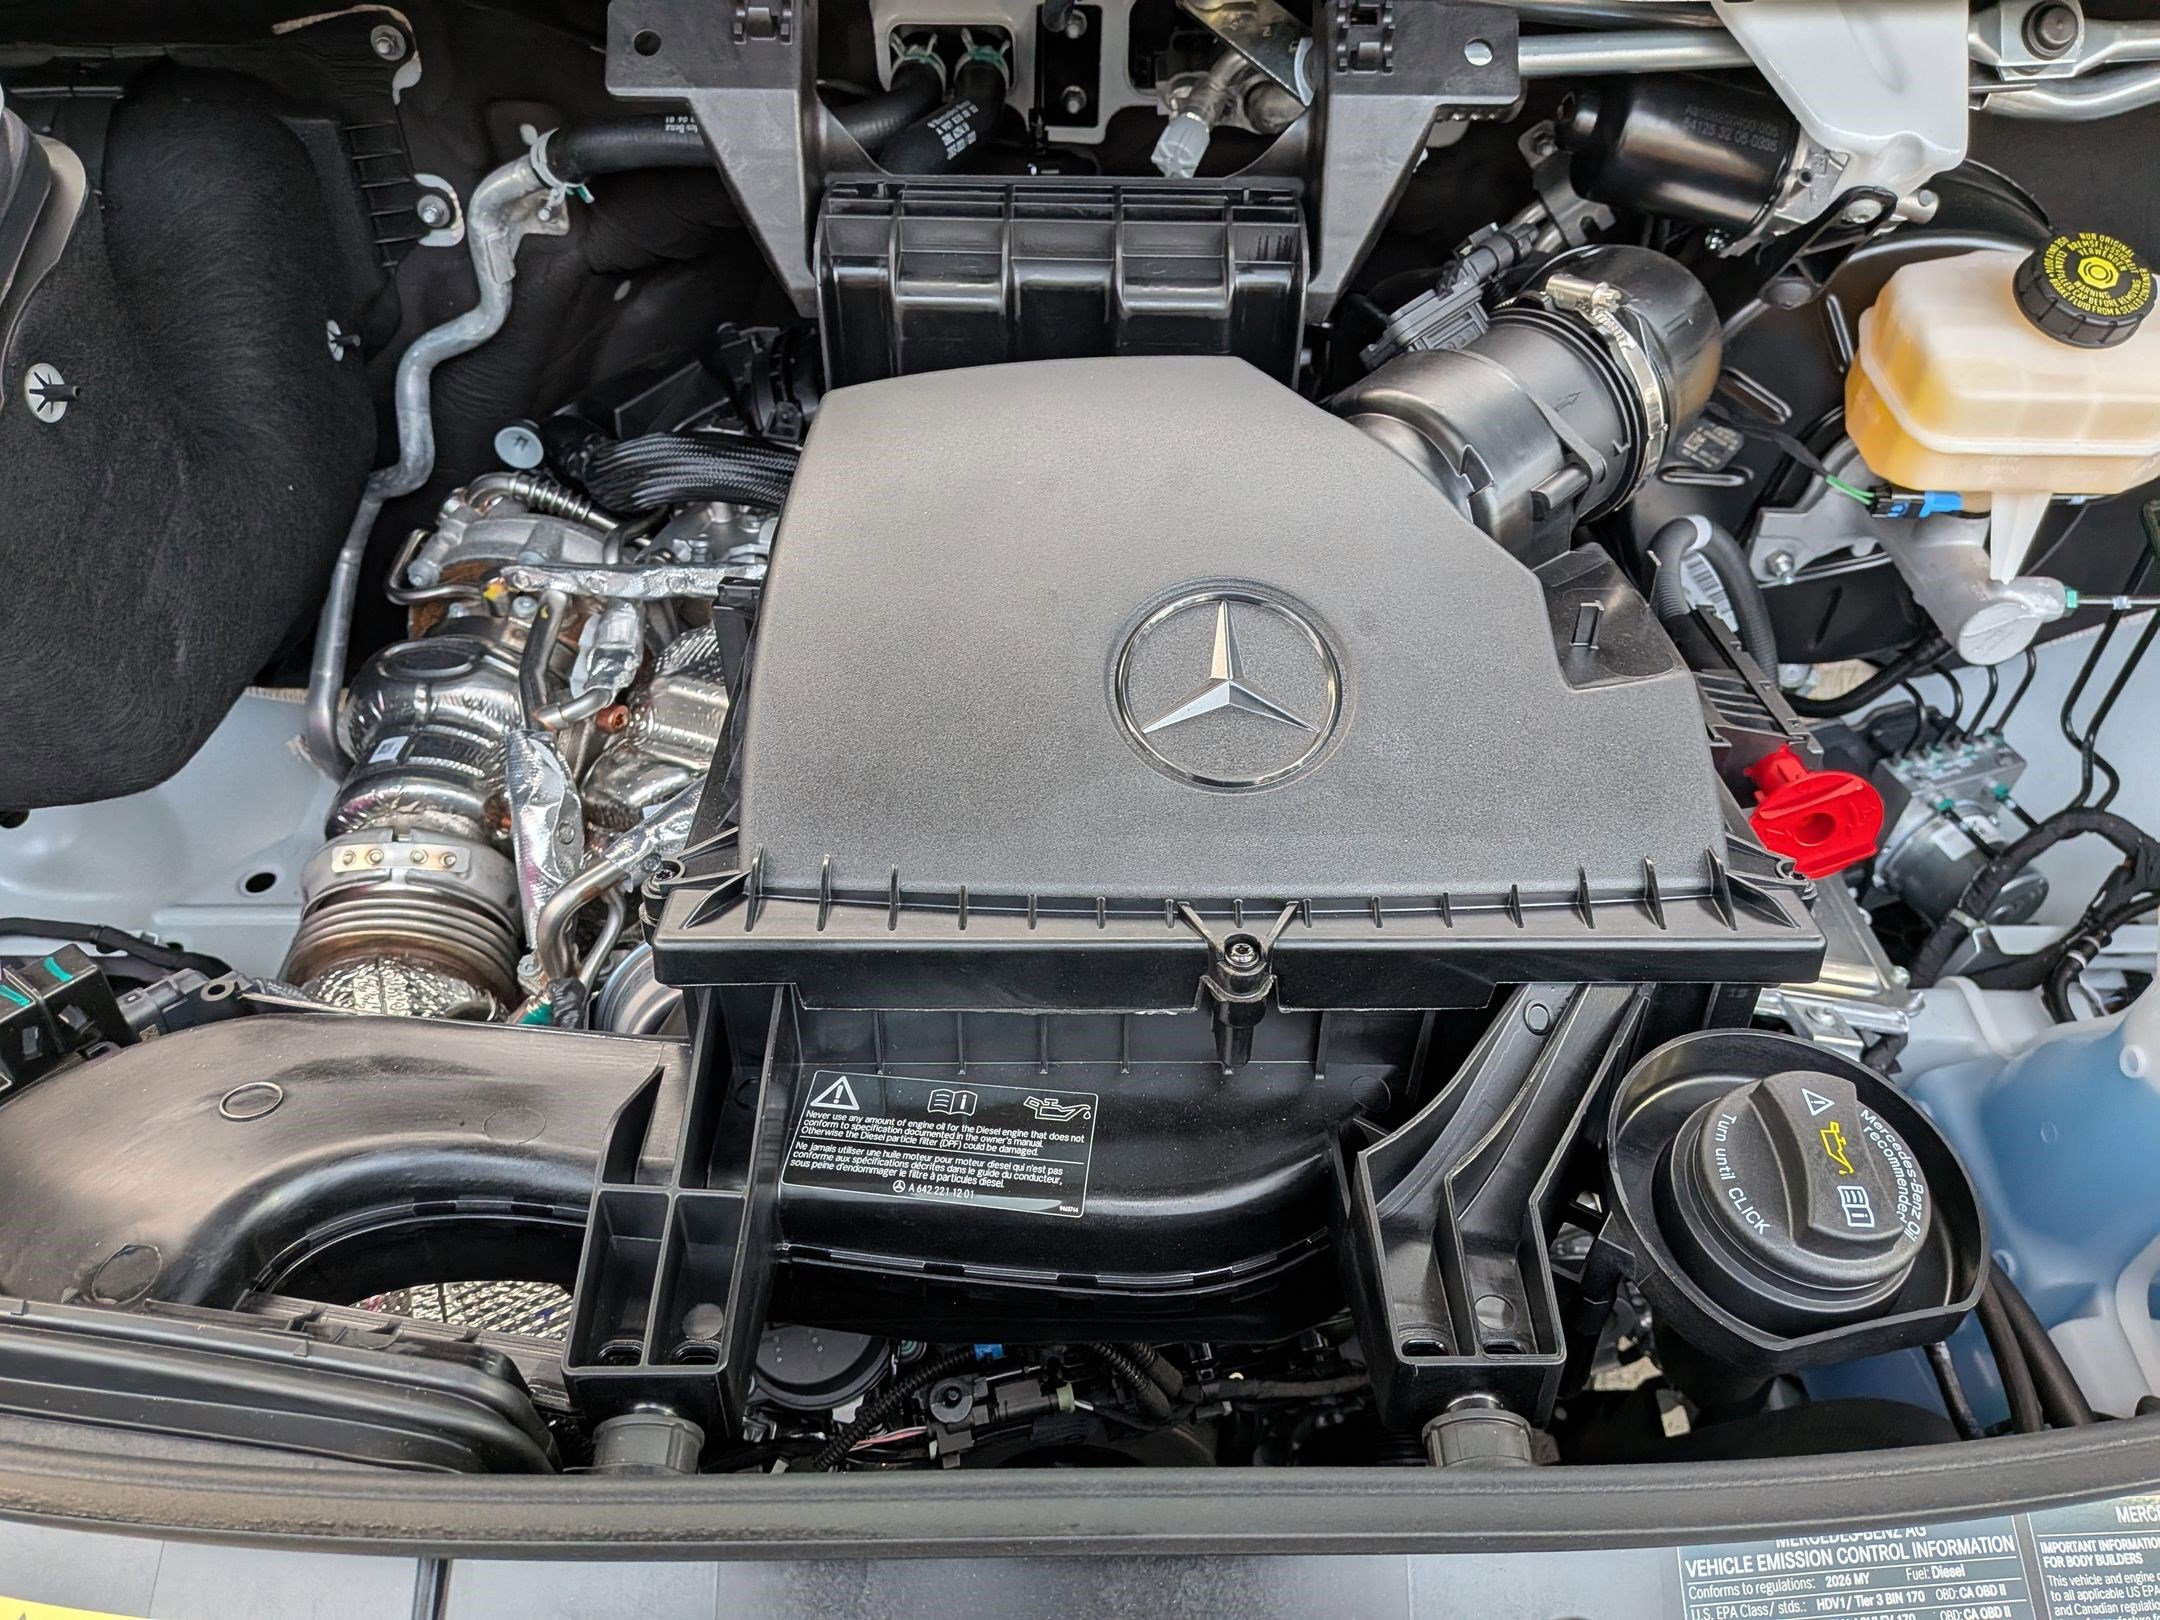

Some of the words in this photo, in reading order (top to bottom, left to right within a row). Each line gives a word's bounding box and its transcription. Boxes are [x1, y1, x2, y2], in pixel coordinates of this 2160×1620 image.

[2079, 232, 2097, 241] NUR
[2099, 234, 2135, 258] ORIGINAL
[2055, 250, 2068, 269] CLEAN
[2077, 247, 2128, 271] VERWENDEN
[2055, 270, 2075, 292] FILLER
[2073, 280, 2111, 300] WARNING
[2068, 296, 2091, 311] FLUID
[2092, 305, 2115, 316] FROM
[2120, 298, 2145, 314] SEALED
[2072, 290, 2089, 301] CAP
[2088, 297, 2120, 307] BEFORE
[803, 1118, 839, 1129] conform
[840, 1121, 849, 1130] to
[850, 1122, 903, 1136] specification
[904, 1127, 956, 1140] documented
[956, 1131, 964, 1140] in
[965, 1133, 979, 1142] the
[980, 1135, 1013, 1145] owner's
[805, 1110, 831, 1120] Never
[832, 1114, 848, 1122] use
[849, 1115, 864, 1123] any
[864, 1116, 895, 1126] amount
[896, 1119, 907, 1127] of
[907, 1121, 934, 1131] engine
[935, 1122, 946, 1130] oil
[947, 1123, 960, 1132] for
[961, 1125, 975, 1133] the
[976, 1125, 1001, 1136] Diesel
[1002, 1128, 1029, 1138] engine
[1030, 1130, 1047, 1140] that
[1048, 1132, 1069, 1142] does
[1070, 1134, 1085, 1143] not
[1715, 1113, 1737, 1142] Turn
[801, 1126, 844, 1137] Otherwise
[845, 1129, 860, 1139] the
[860, 1130, 886, 1141] Diesel
[885, 1133, 918, 1145] particle
[918, 1137, 938, 1147] filter
[939, 1139, 962, 1150] (DPF)
[963, 1141, 986, 1151] could
[986, 1143, 998, 1152] be
[998, 1145, 1039, 1157] damaged.
[792, 1150, 835, 1162] conforme
[835, 1154, 850, 1163] aux
[851, 1155, 909, 1169] spécifications
[910, 1160, 946, 1172] décrites
[946, 1163, 967, 1174] dans
[967, 1166, 976, 1175] le
[976, 1168, 1000, 1179] guide
[1001, 1170, 1012, 1179] du
[1013, 1172, 1063, 1186] conducteur,
[795, 1141, 809, 1151] Ne
[808, 1142, 837, 1154] jamais
[838, 1145, 865, 1156] utiliser
[866, 1148, 882, 1157] une
[882, 1149, 902, 1159] huile
[902, 1151, 935, 1162] moteur
[935, 1155, 954, 1166] pour
[954, 1157, 985, 1168] moteur
[987, 1160, 1012, 1171] diesel
[1012, 1163, 1026, 1173] qui
[1026, 1164, 1047, 1175] n'est
[1047, 1167, 1064, 1177] pas
[1715, 1148, 1736, 1180] until
[790, 1160, 811, 1168] sous
[811, 1161, 835, 1171] peine
[836, 1163, 897, 1178] d'endommager
[899, 1169, 907, 1178] le
[908, 1170, 929, 1180] filtre
[929, 1172, 936, 1181] à
[935, 1173, 977, 1186] particules
[1860, 1109, 1924, 1220] Mercedes-Benz
[1904, 1220, 1921, 1242] Oil
[908, 1182, 915, 1193] A
[916, 1184, 933, 1195] 642
[934, 1186, 950, 1197] 221
[953, 1188, 963, 1198] 12
[963, 1189, 974, 1199] 01
[1728, 1187, 1771, 1235] CLICK
[1905, 1526, 1927, 1538] AG
[1685, 1555, 1754, 1578] VEHICLE
[1757, 1548, 1834, 1572] EMISSION
[1836, 1542, 1910, 1565] CONTROL
[1911, 1535, 2016, 1559] INFORMATION
[2040, 1540, 2097, 1554] IMPORTANT
[1905, 1566, 1931, 1581] Fuel:
[1931, 1563, 1966, 1579] Diesel
[2043, 1555, 2066, 1569] FOR
[2066, 1554, 2094, 1568] BODY
[2094, 1552, 2144, 1567] BUILDERS
[1688, 1582, 1740, 1600] Conforms
[1742, 1580, 1754, 1595] to
[1756, 1577, 1816, 1597] regulations:
[1825, 1573, 1852, 1588] 2026
[1854, 1571, 1870, 1586] MY
[2047, 1574, 2069, 1587] This
[2069, 1573, 2103, 1587] vehicle
[2104, 1572, 2123, 1585] and
[2123, 1571, 2156, 1586] engine
[1690, 1607, 1715, 1620] U.S.
[1717, 1604, 1739, 1620] EPA
[1740, 1601, 1775, 1619] Class/
[1854, 1594, 1875, 1608] Tier
[1875, 1593, 1884, 1606] 3
[1885, 1591, 1904, 1605] BIN
[1906, 1590, 1926, 1603] 170
[2050, 1589, 2061, 1602] to
[2064, 1589, 2076, 1602] all
[2077, 1587, 2125, 1603] applicable
[2125, 1585, 2141, 1598] US
[2142, 1584, 2160, 1597] EPA
[2054, 1603, 2074, 1617] and
[2074, 1602, 2119, 1616] Canadian
